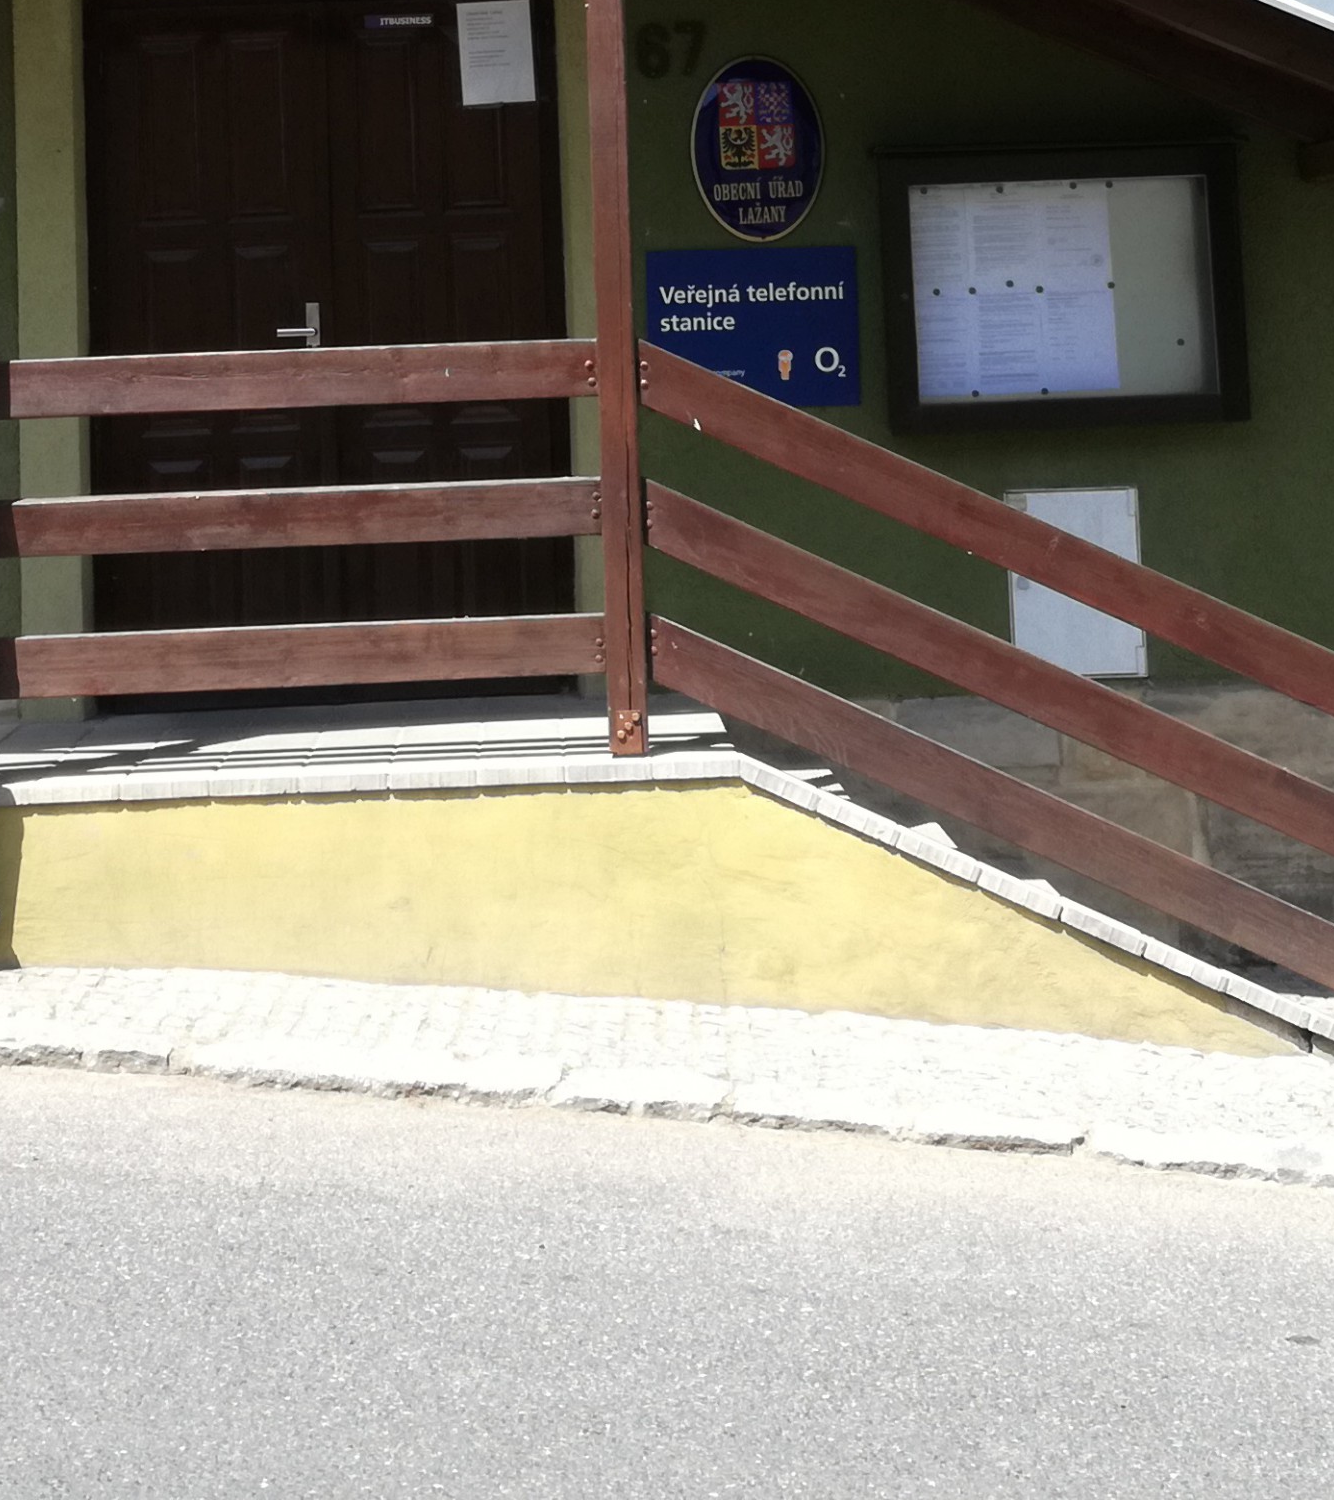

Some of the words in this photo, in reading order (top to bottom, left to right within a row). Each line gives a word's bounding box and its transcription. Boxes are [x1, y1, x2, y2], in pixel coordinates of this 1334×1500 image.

[379, 16, 432, 26] ITBUSINESS
[634, 19, 706, 79] 67
[713, 177, 762, 201] OBECNÍ
[768, 175, 803, 199] ÚŘAD
[738, 202, 787, 225] LAŽANY
[658, 283, 741, 308] Veřejná
[746, 280, 845, 302] telefonní
[660, 311, 736, 332] stanice
